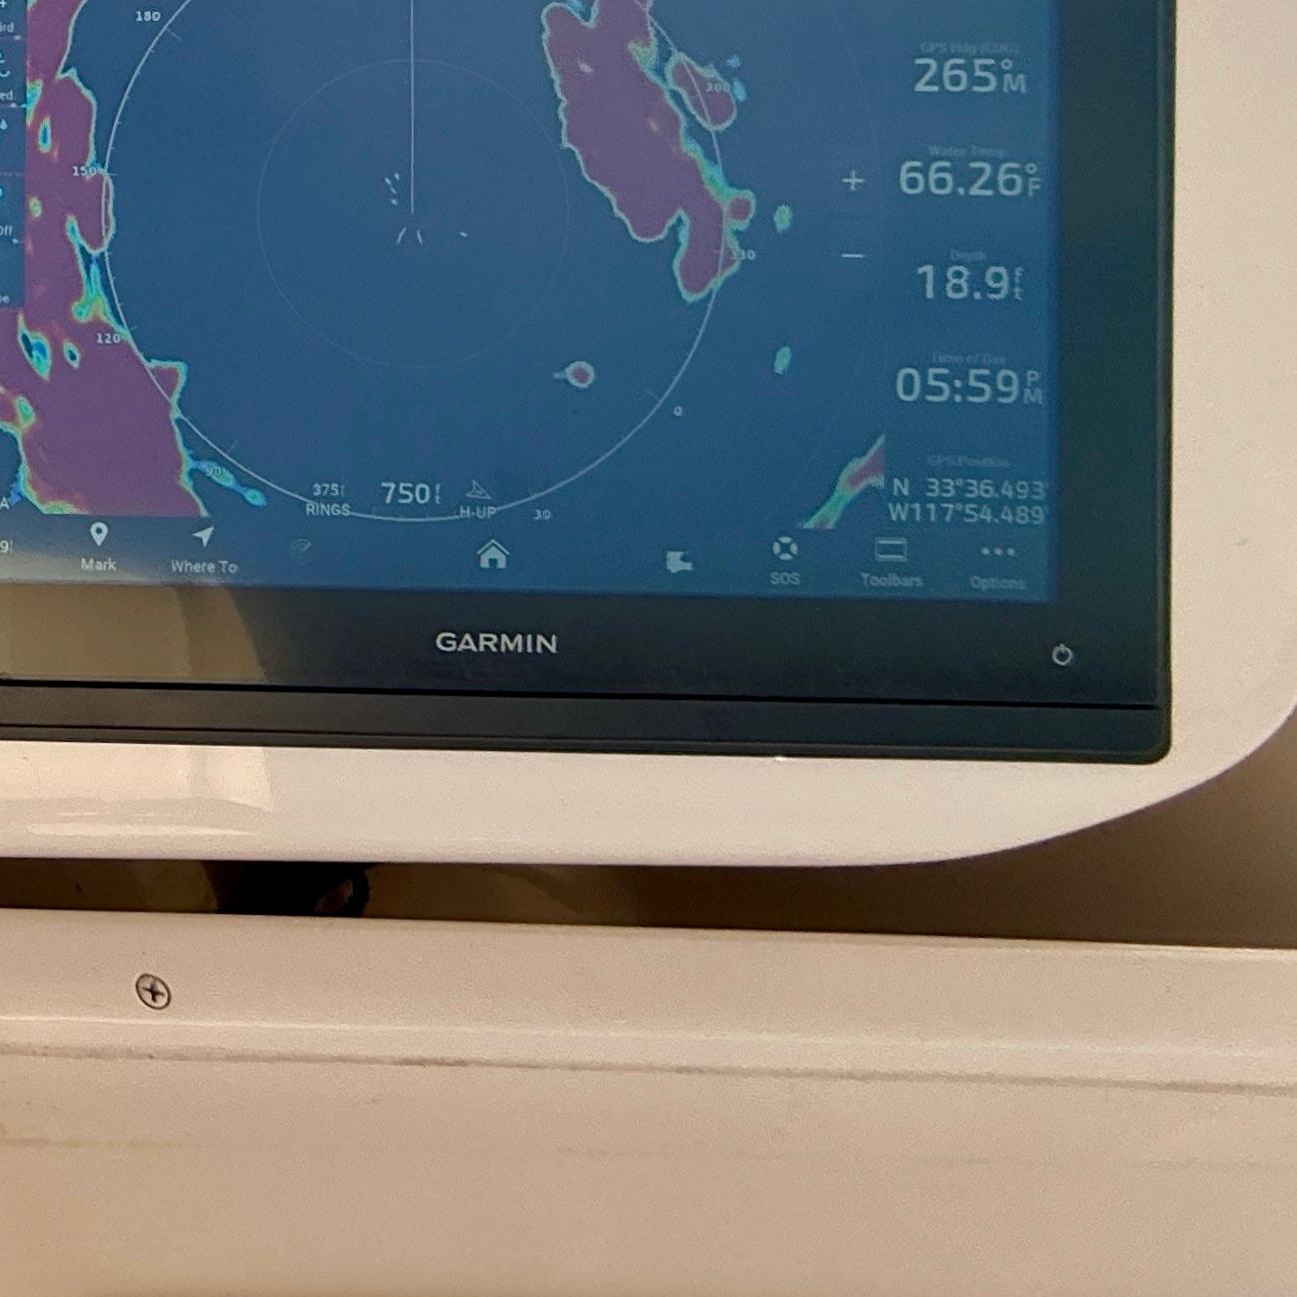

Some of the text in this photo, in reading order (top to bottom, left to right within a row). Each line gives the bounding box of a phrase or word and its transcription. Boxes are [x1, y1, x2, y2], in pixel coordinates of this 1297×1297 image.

[913, 57, 997, 93] 265
[899, 160, 1023, 196] 66.26
[917, 264, 1010, 301] 18.9
[96, 333, 121, 344] 120
[895, 367, 1020, 404] 05:59
[312, 483, 340, 496] 375
[381, 481, 431, 504] 750
[893, 478, 910, 497] N
[306, 504, 352, 517] RINGS
[460, 506, 497, 519] H-UP
[81, 558, 117, 572] Mark
[171, 560, 238, 574] Where To
[770, 571, 800, 586] SOS
[861, 572, 923, 588] Toolbars
[970, 575, 1027, 592] Options
[435, 632, 557, 654] GARMIN
